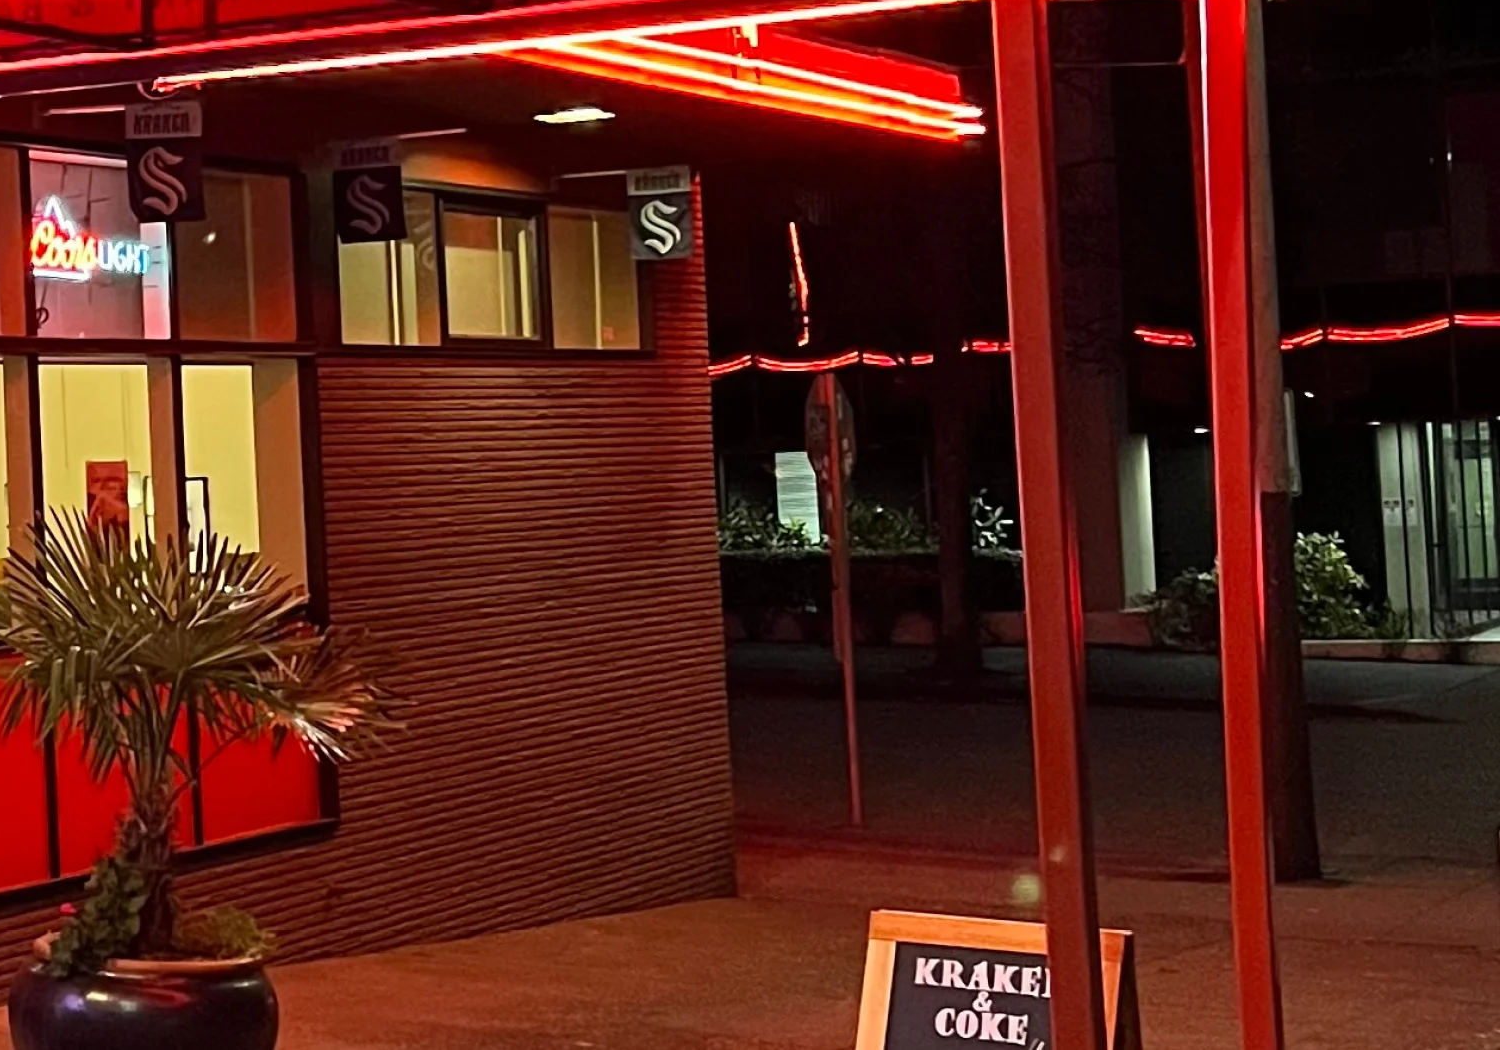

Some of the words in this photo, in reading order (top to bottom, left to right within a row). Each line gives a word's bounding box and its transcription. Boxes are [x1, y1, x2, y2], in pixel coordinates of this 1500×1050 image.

[98, 239, 150, 274] LIGHT
[972, 991, 993, 1012] &
[935, 1008, 1029, 1045] COKE
